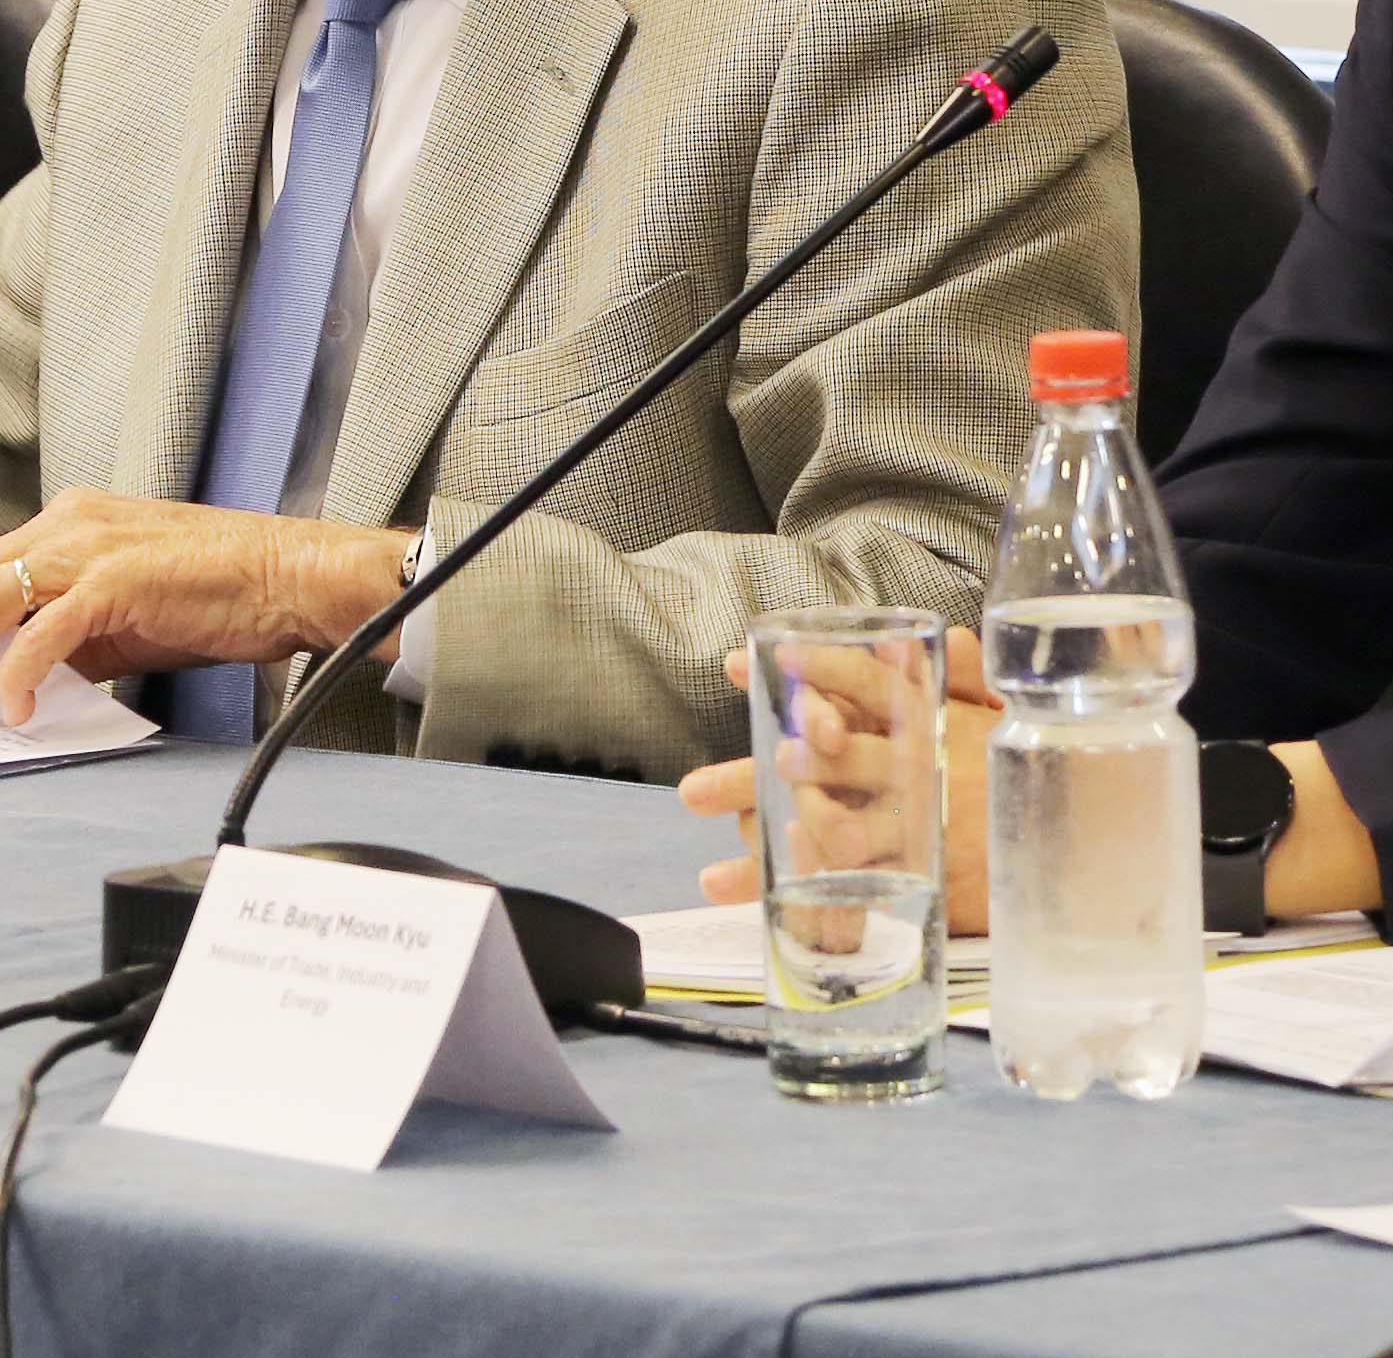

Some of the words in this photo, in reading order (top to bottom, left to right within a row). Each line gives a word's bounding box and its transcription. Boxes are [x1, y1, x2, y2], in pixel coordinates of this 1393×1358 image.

[238, 898, 277, 924] H.E.
[283, 904, 333, 938] Bang
[334, 913, 390, 940] Moon
[392, 922, 431, 951] Kyu
[398, 977, 432, 995] and
